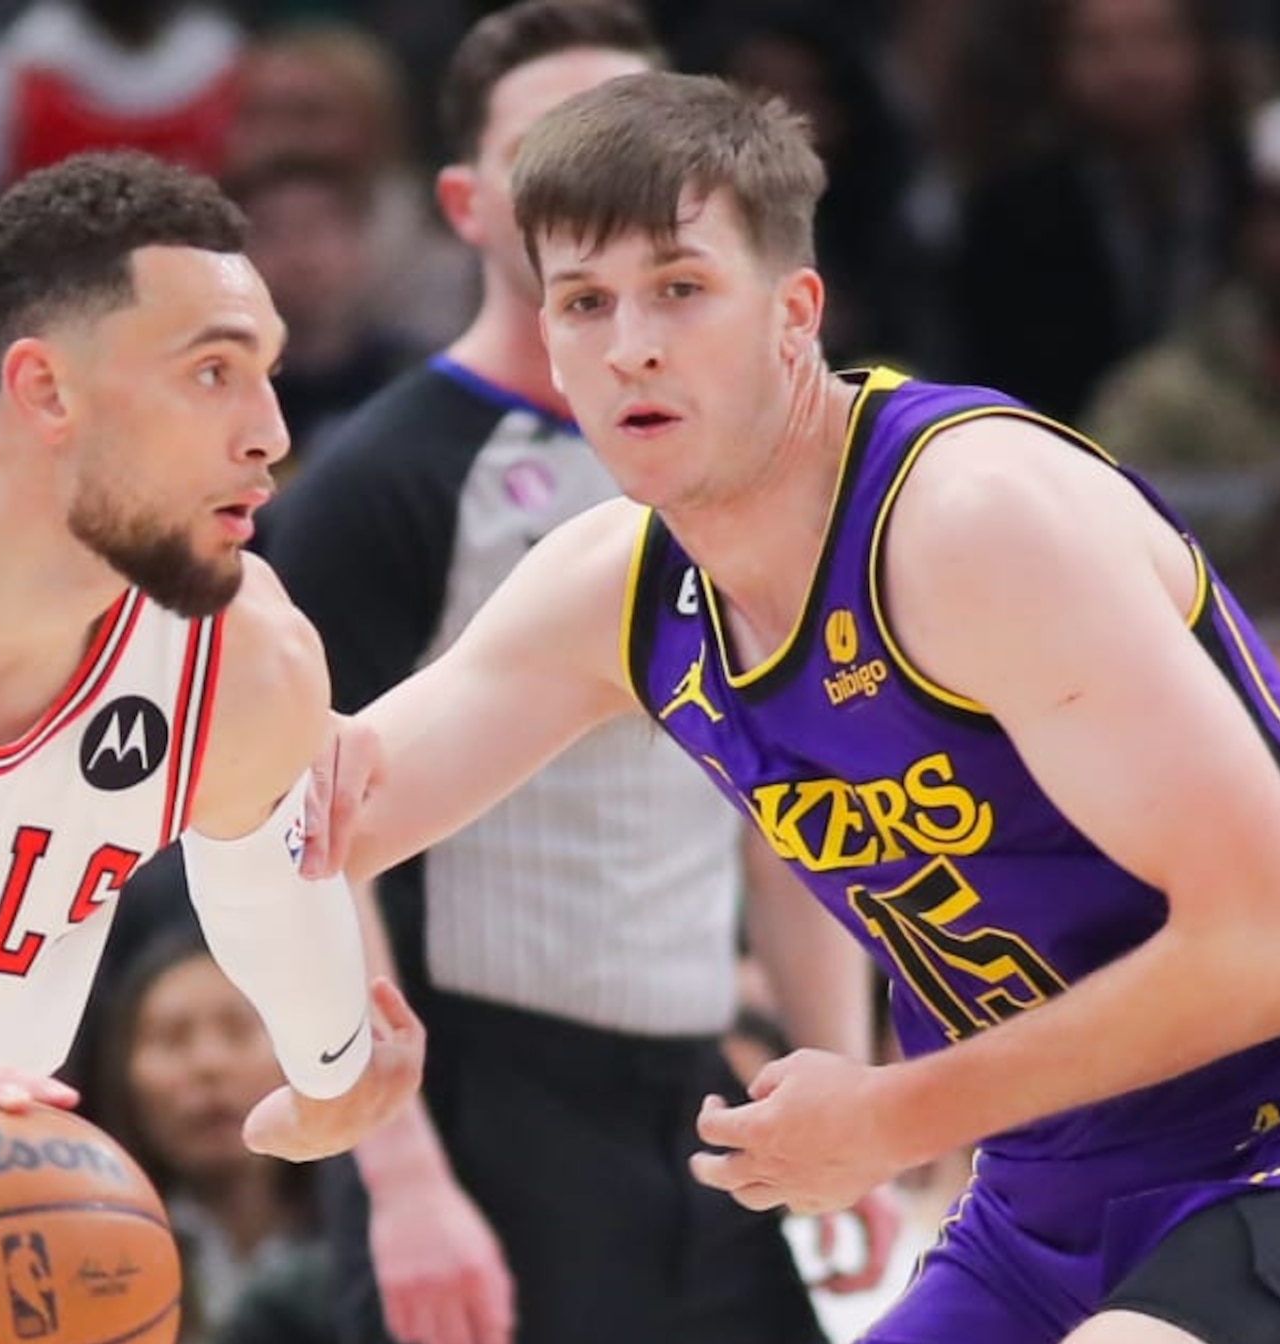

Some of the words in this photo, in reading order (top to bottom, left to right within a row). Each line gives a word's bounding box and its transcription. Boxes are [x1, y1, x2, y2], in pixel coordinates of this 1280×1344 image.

[823, 659, 887, 705] bibigo
[752, 753, 993, 872] KERS
[846, 855, 1070, 1042] 15
